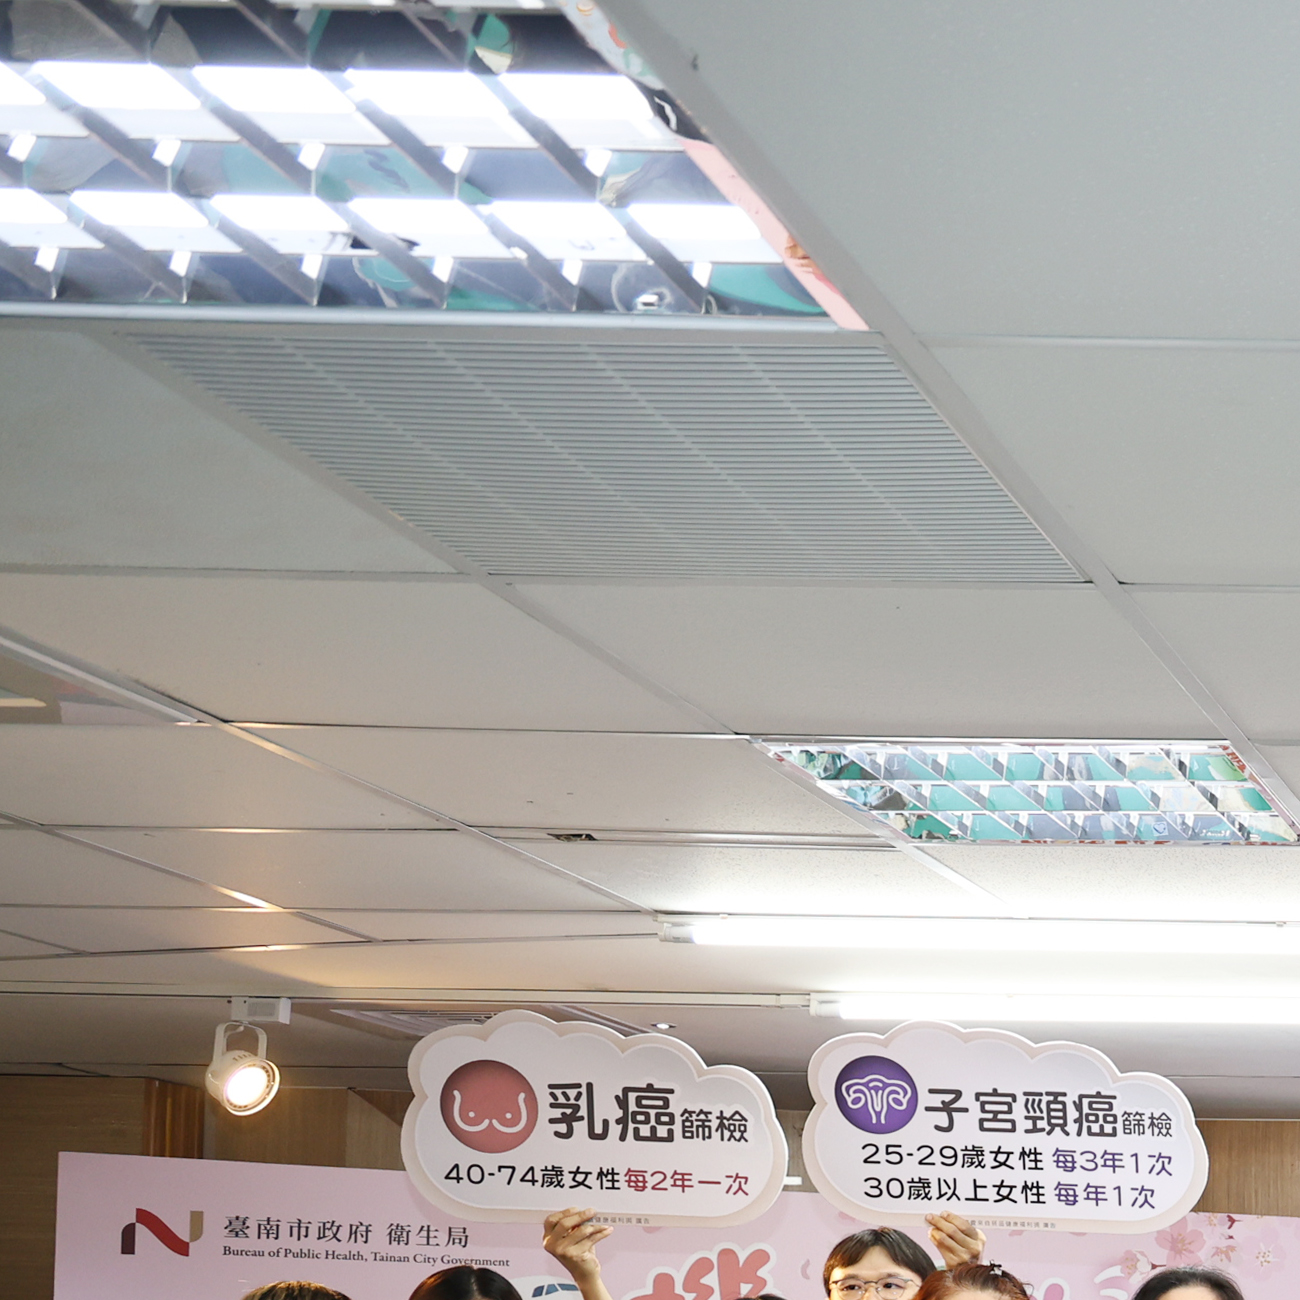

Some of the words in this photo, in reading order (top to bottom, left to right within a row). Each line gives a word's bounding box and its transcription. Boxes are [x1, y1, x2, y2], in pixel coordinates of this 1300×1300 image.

[547, 1081, 749, 1143] 乳癌篩檢
[924, 1087, 1174, 1138] 子宮頸癌篩檢
[861, 1143, 1045, 1172] 25-29歲女性
[444, 1163, 750, 1197] 40-74歲女性每2年一次
[863, 1176, 1047, 1205] 30歲以上女性
[223, 1215, 374, 1244] 臺南市政府
[387, 1222, 470, 1248] 衛生局
[222, 1245, 266, 1258] Bureau
[268, 1247, 284, 1260] of
[284, 1248, 322, 1261] Public
[325, 1250, 368, 1263] Health,
[371, 1251, 410, 1263] Tainan
[413, 1253, 439, 1267] City
[440, 1254, 510, 1267] Government
